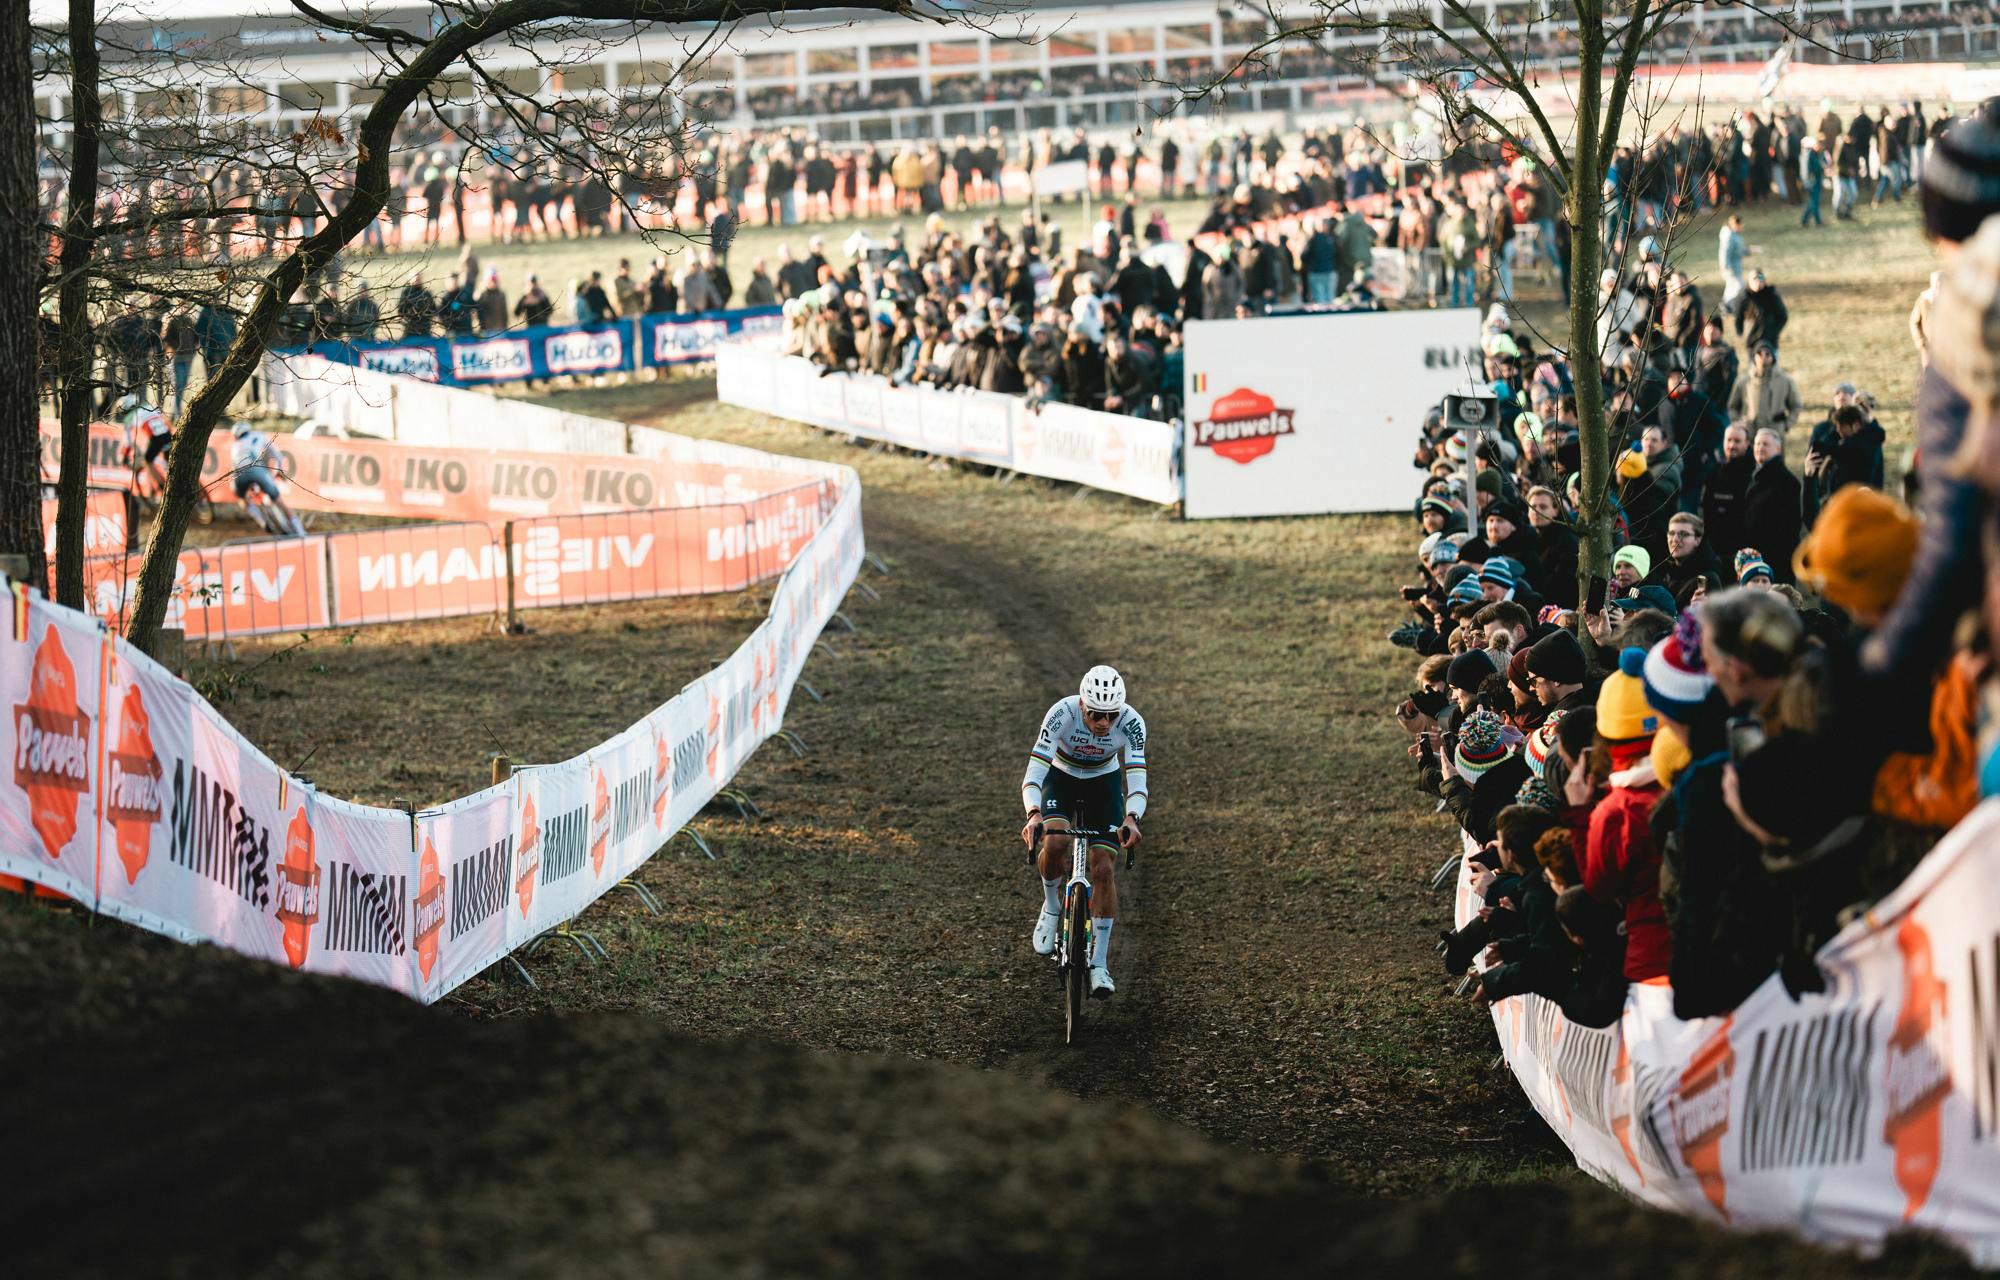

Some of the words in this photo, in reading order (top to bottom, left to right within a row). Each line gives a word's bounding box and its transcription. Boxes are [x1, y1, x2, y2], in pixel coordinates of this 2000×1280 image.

[551, 337, 617, 366] Hubo
[1199, 408, 1289, 443] Pauwels
[319, 453, 381, 487] IKO
[404, 458, 467, 494] IKO
[491, 463, 558, 499] IKO
[583, 468, 655, 507] IKO
[18, 713, 87, 780] Pauwels
[1125, 717, 1145, 751] Alpecin
[110, 758, 160, 822] Pauwels
[276, 869, 319, 917] Pauwels
[415, 884, 444, 938] Pauwels
